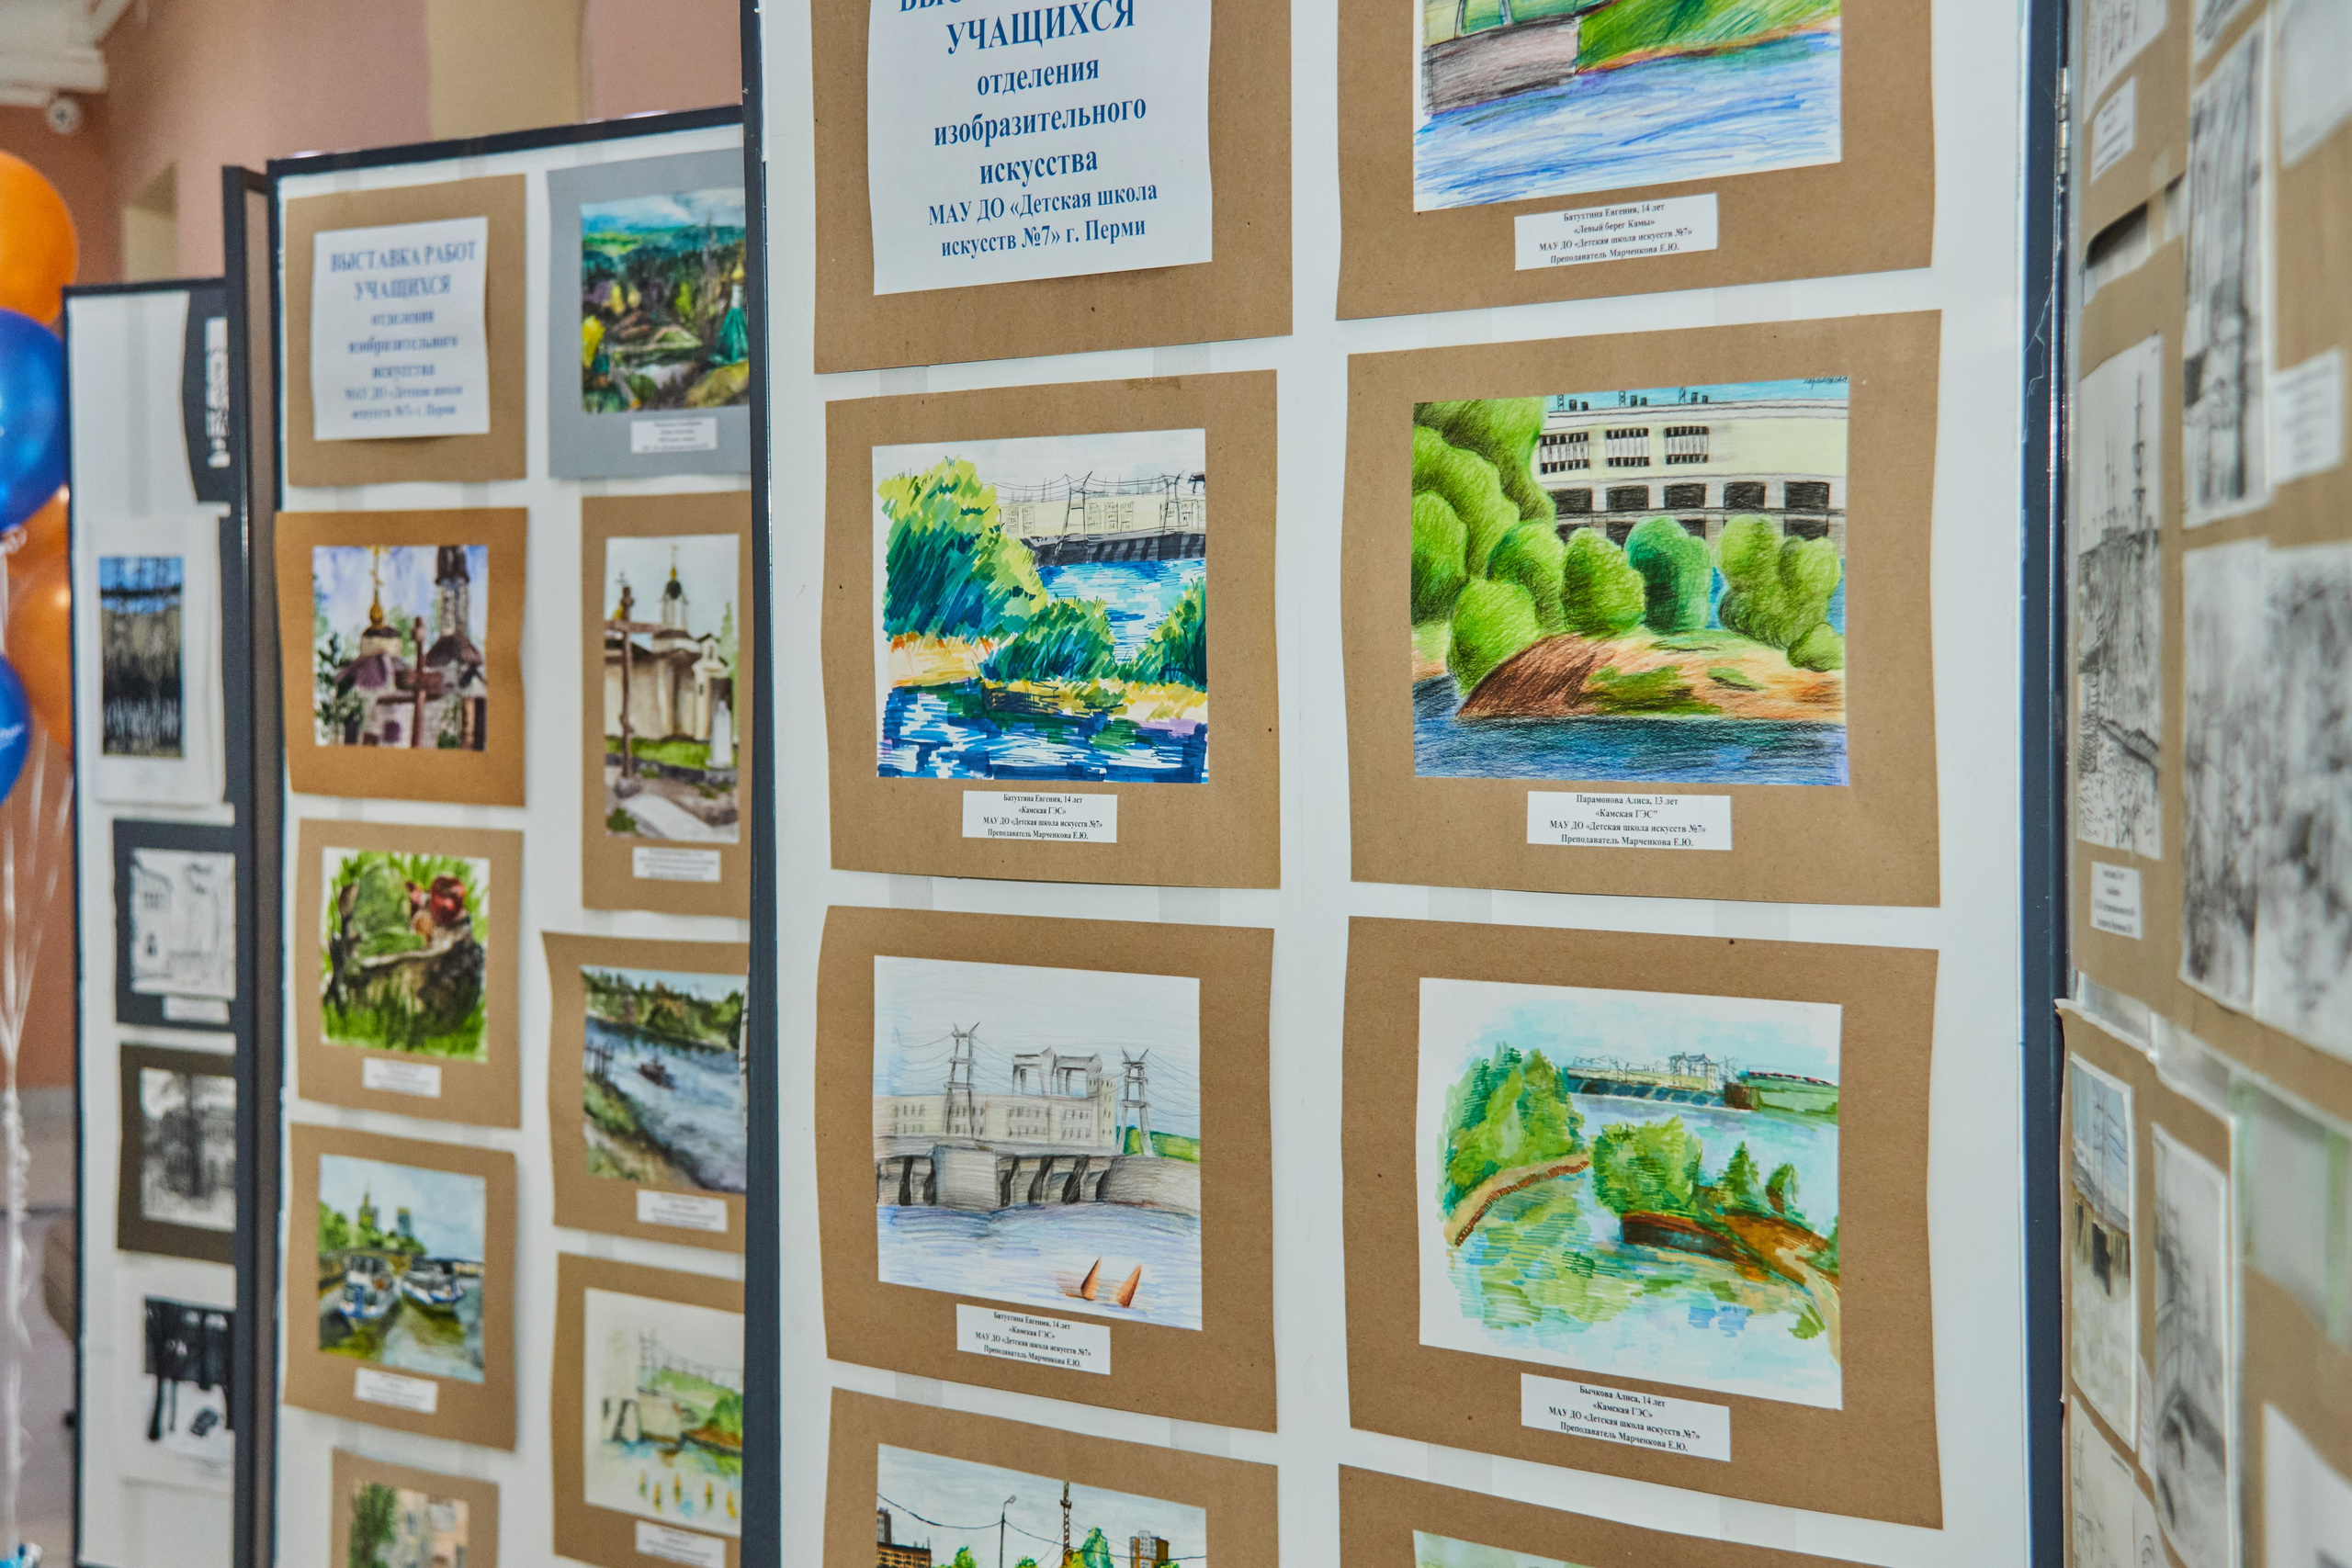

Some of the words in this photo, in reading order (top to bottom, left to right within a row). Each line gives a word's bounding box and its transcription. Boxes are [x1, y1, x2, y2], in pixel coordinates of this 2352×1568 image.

[946, 0, 1136, 55] УЧАЩИХСЯ
[977, 60, 1099, 96] отделения
[933, 98, 1147, 148] изобразительного
[980, 151, 1098, 187] искусства
[928, 201, 972, 227] МАУ
[977, 197, 1005, 223] ДО
[1010, 193, 1091, 220] «Детская
[1097, 184, 1158, 206] школа
[1564, 210, 1602, 222] Батухтина
[1605, 206, 1639, 218] Евгения,
[1642, 205, 1650, 213] 14
[1574, 220, 1603, 234] «Левый
[1605, 220, 1625, 232] берег
[1628, 219, 1655, 228] Камы»
[942, 234, 1016, 259] искусств
[1022, 224, 1060, 248] №7»
[1067, 230, 1080, 243] г.
[1085, 220, 1146, 245] Перми
[1540, 242, 1558, 252] МАУ
[1560, 241, 1572, 250] ДО
[1575, 237, 1608, 248] «Детская
[1611, 235, 1635, 243] школа
[1638, 231, 1672, 243] искусств
[1675, 228, 1692, 237] №7»
[331, 247, 421, 273] ВЫСТАВКА
[424, 242, 476, 265] РАБОТ
[1550, 250, 1606, 265] Преподаватель
[1610, 245, 1657, 259] Марченкова
[1660, 243, 1679, 253] Е.Ю.
[1004, 794, 1034, 803] Батухтина
[1035, 795, 1062, 803] Евгения,
[1577, 795, 1623, 805] Парамонова
[1011, 818, 1036, 826] «Детская
[1550, 820, 1569, 829] МАУ
[1571, 821, 1583, 830] ДО
[1586, 822, 1620, 831] «Детская
[1651, 826, 1686, 834] искусств
[1689, 824, 1705, 833] №7»
[988, 829, 1031, 838] Преподаватель
[1033, 830, 1071, 840] Марченкова
[1561, 835, 1619, 844] Преподаватель
[1622, 837, 1670, 847] Марченкова
[994, 1312, 1023, 1323] Батухтина
[1025, 1316, 1051, 1327] Евгения,
[1009, 1326, 1036, 1337] «Камская
[1038, 1330, 1055, 1338] ГЭС»
[976, 1332, 989, 1340] МАУ
[1002, 1337, 1027, 1347] «Детская
[1050, 1345, 1076, 1355] искусств
[984, 1345, 1026, 1358] Преподаватель
[1028, 1352, 1065, 1364] Марченкова
[1067, 1359, 1081, 1367] Е.Ю.
[1580, 1386, 1613, 1399] Бычкова
[1615, 1393, 1640, 1404] Алиса,
[1593, 1402, 1629, 1414] «Камская
[1631, 1407, 1653, 1418] ГЭС»
[1549, 1406, 1567, 1416] МАУ
[1569, 1410, 1581, 1420] ДО
[1584, 1413, 1618, 1426] «Детская
[1620, 1420, 1644, 1430] школа
[1646, 1425, 1680, 1438] искусств
[1683, 1429, 1700, 1439] №7»
[1561, 1422, 1616, 1439] Преподаватель
[1619, 1432, 1666, 1448] Марченкова
[1668, 1441, 1687, 1451] Е.Ю.
